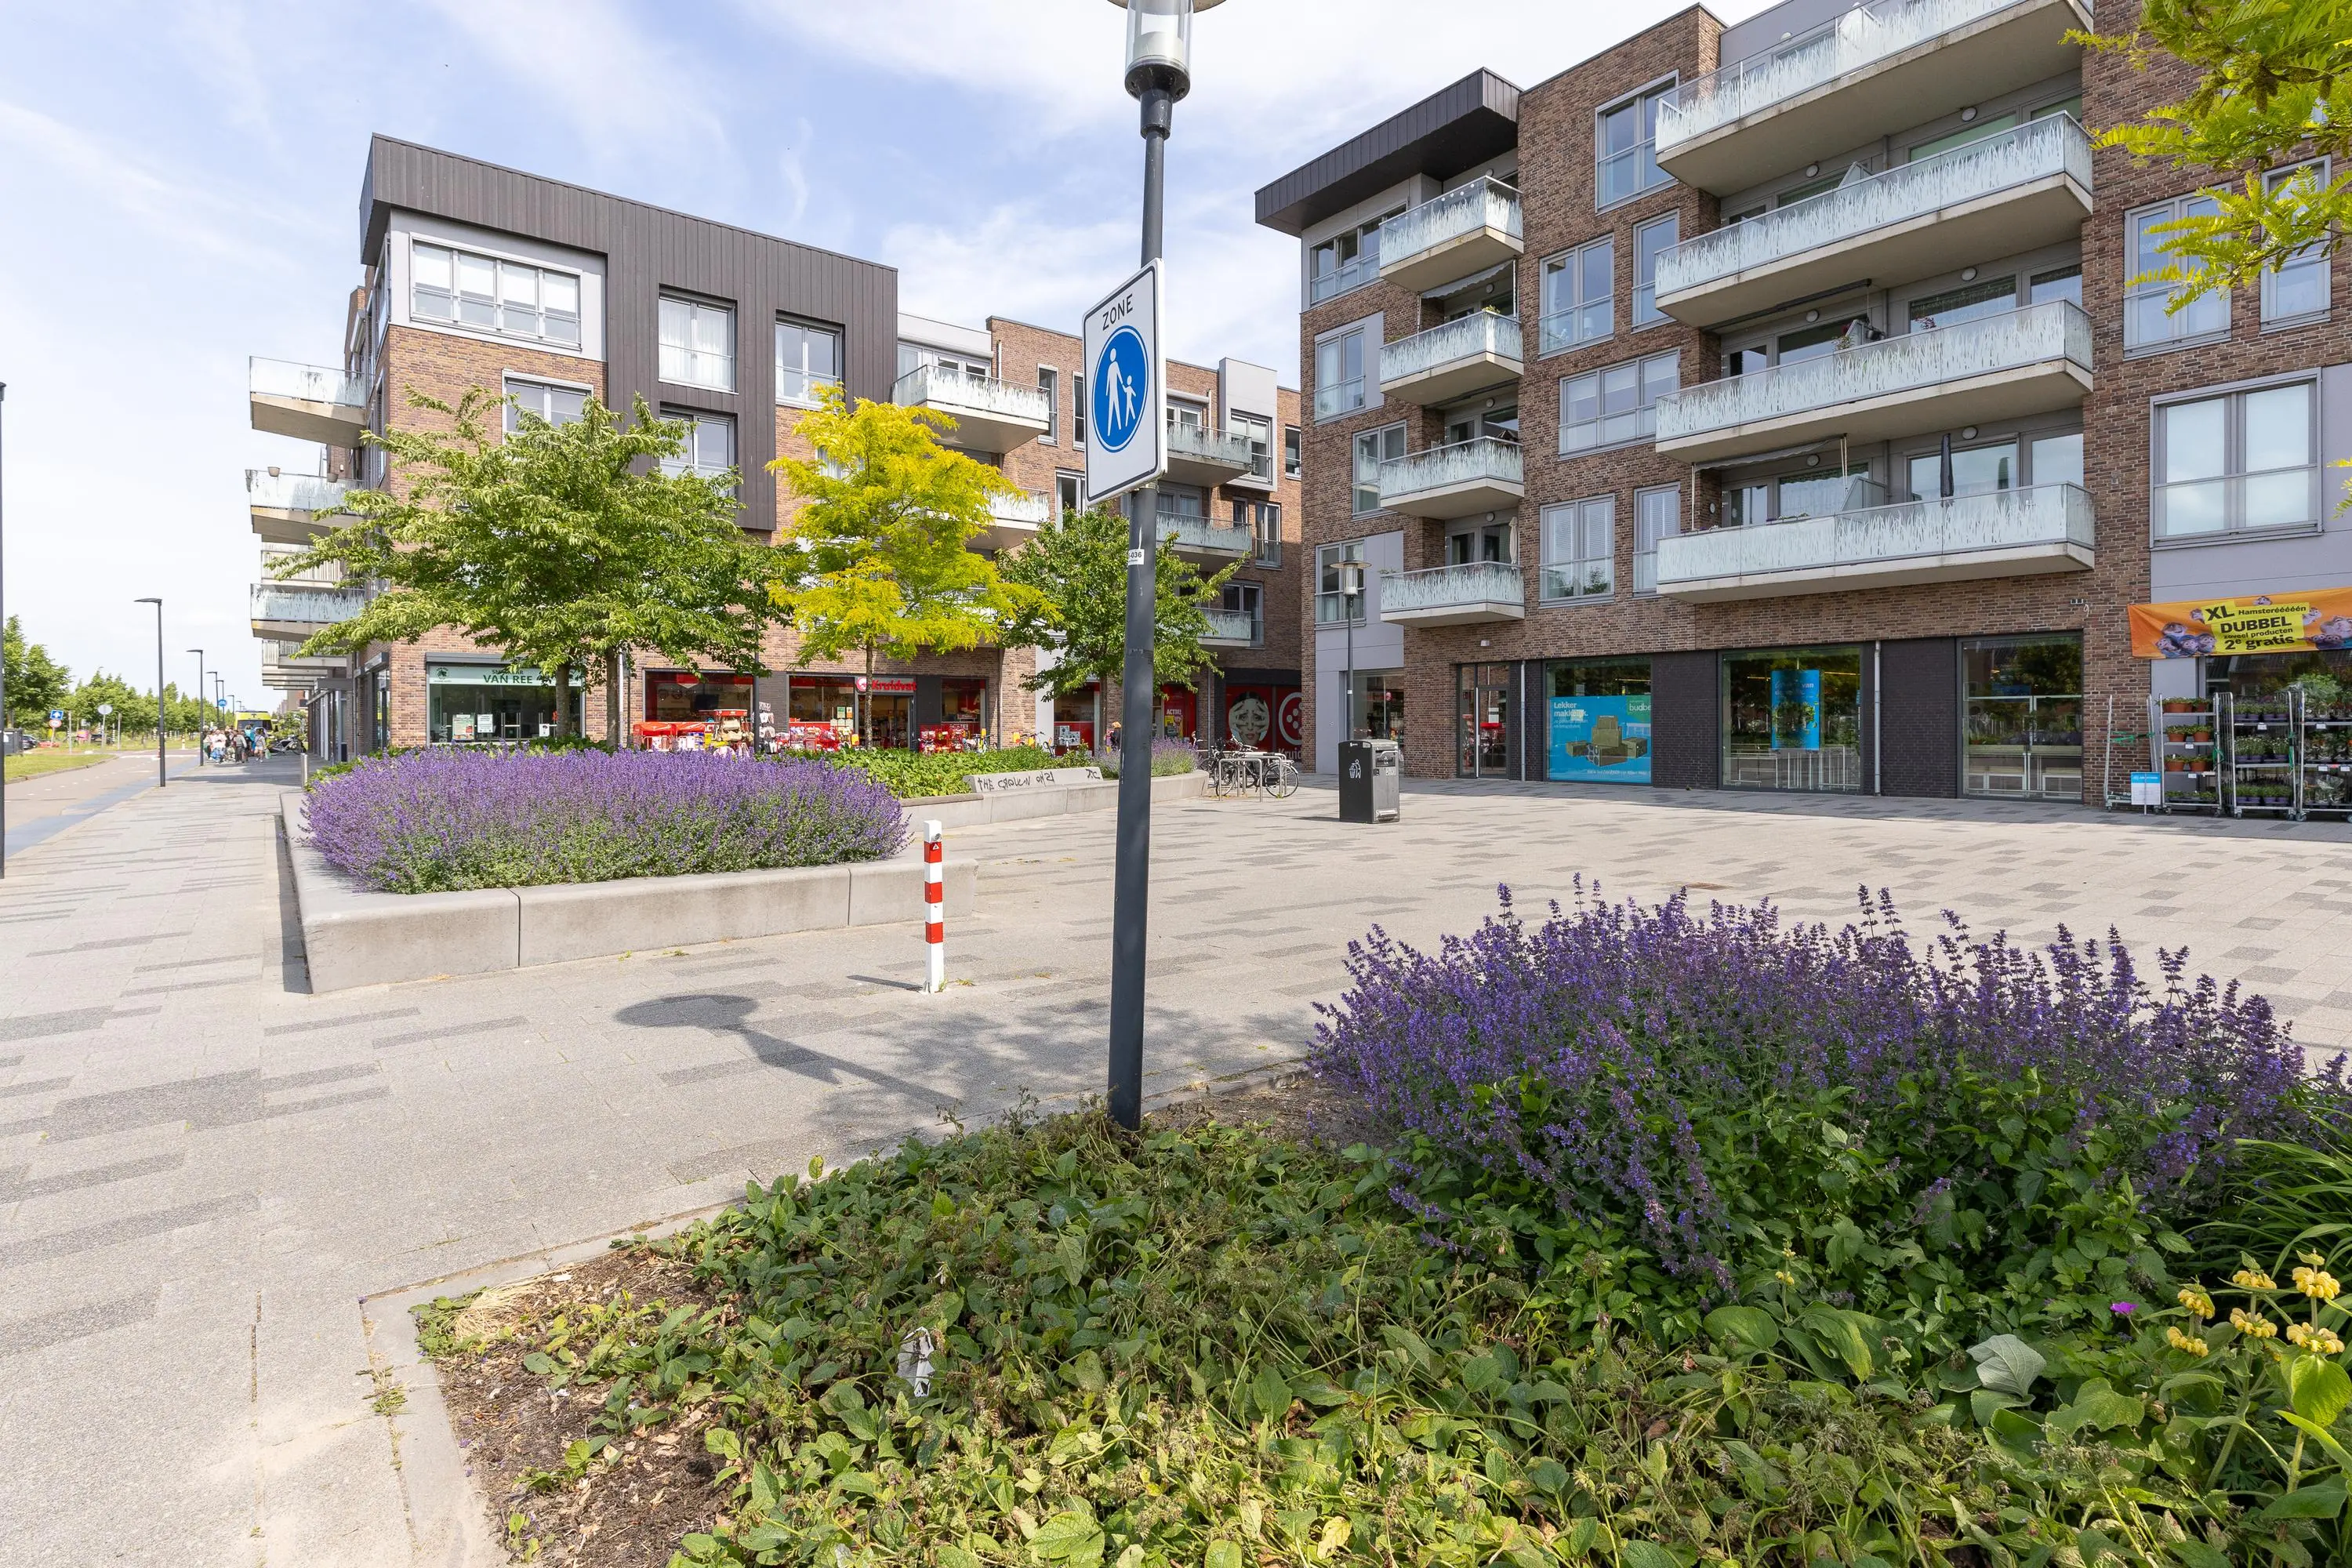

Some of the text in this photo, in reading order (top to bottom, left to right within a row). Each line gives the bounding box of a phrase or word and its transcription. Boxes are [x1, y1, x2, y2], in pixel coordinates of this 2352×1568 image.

[1102, 293, 1134, 330] ZONE
[2205, 605, 2235, 621] XL
[2220, 616, 2292, 633] DUBBEL
[2251, 628, 2293, 637] producten
[2245, 634, 2295, 650] gratis
[483, 674, 533, 684] VAN REE
[872, 679, 917, 691] Kruidvat
